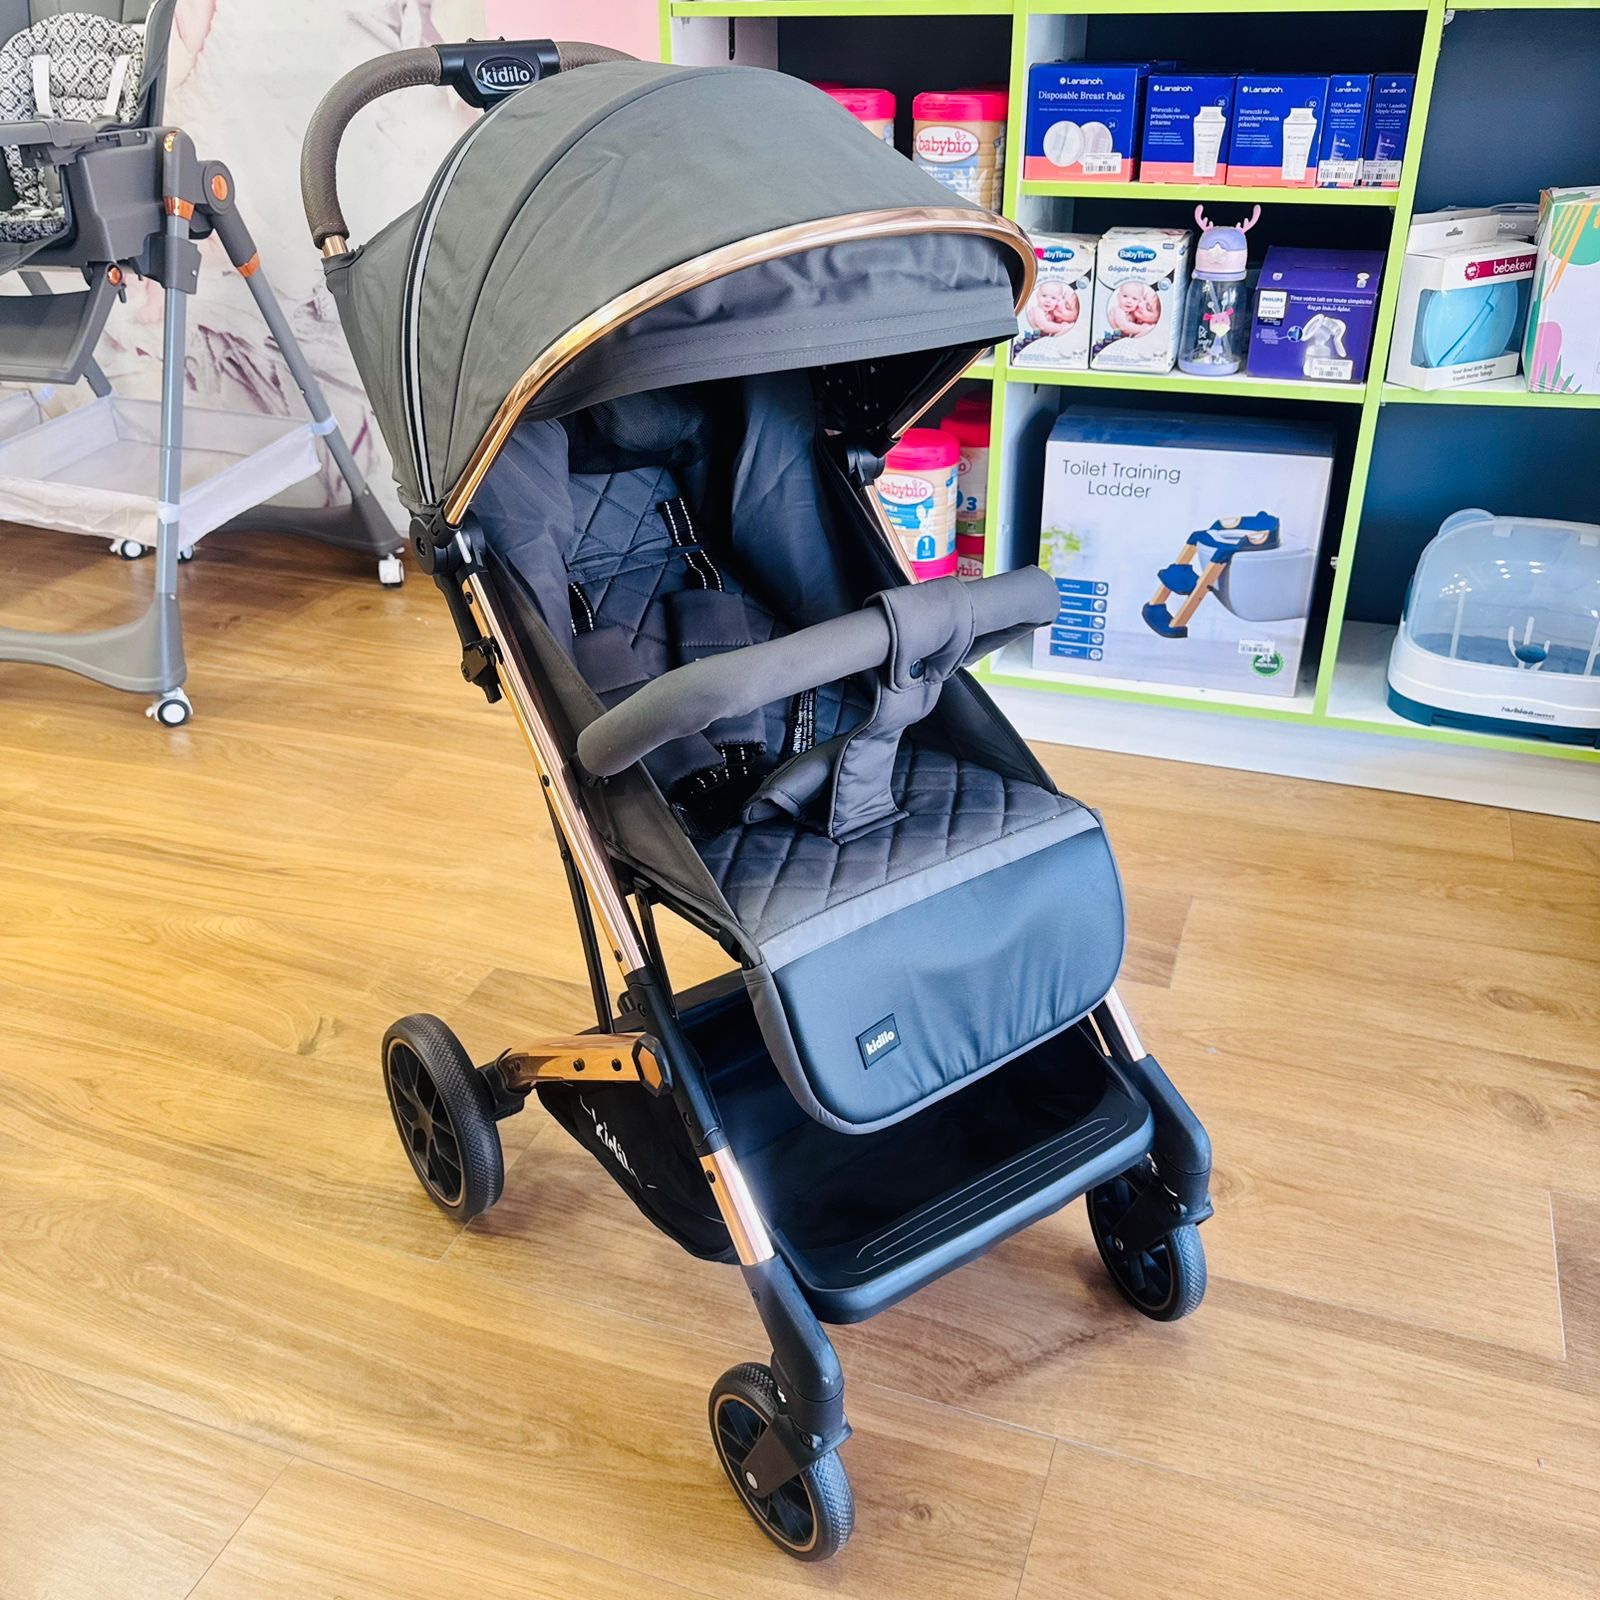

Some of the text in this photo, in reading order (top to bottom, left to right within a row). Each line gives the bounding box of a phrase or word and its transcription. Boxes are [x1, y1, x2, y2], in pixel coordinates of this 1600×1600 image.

[481, 66, 530, 83] kidilo
[1066, 77, 1104, 85] Lansinoh
[1038, 90, 1125, 101] Disposable Breast Pads
[1249, 86, 1284, 94] Lansinoh
[918, 136, 972, 156] babybio
[1043, 250, 1073, 259] abyTime
[1119, 250, 1155, 259] BabyTime
[1493, 258, 1533, 274] bebekevi
[1063, 459, 1181, 484] Toilet Training
[1088, 480, 1151, 498] Ladder
[966, 497, 977, 511] 3
[922, 537, 930, 551] 1
[792, 725, 802, 753] RNING:
[866, 1031, 895, 1056] kidilo
